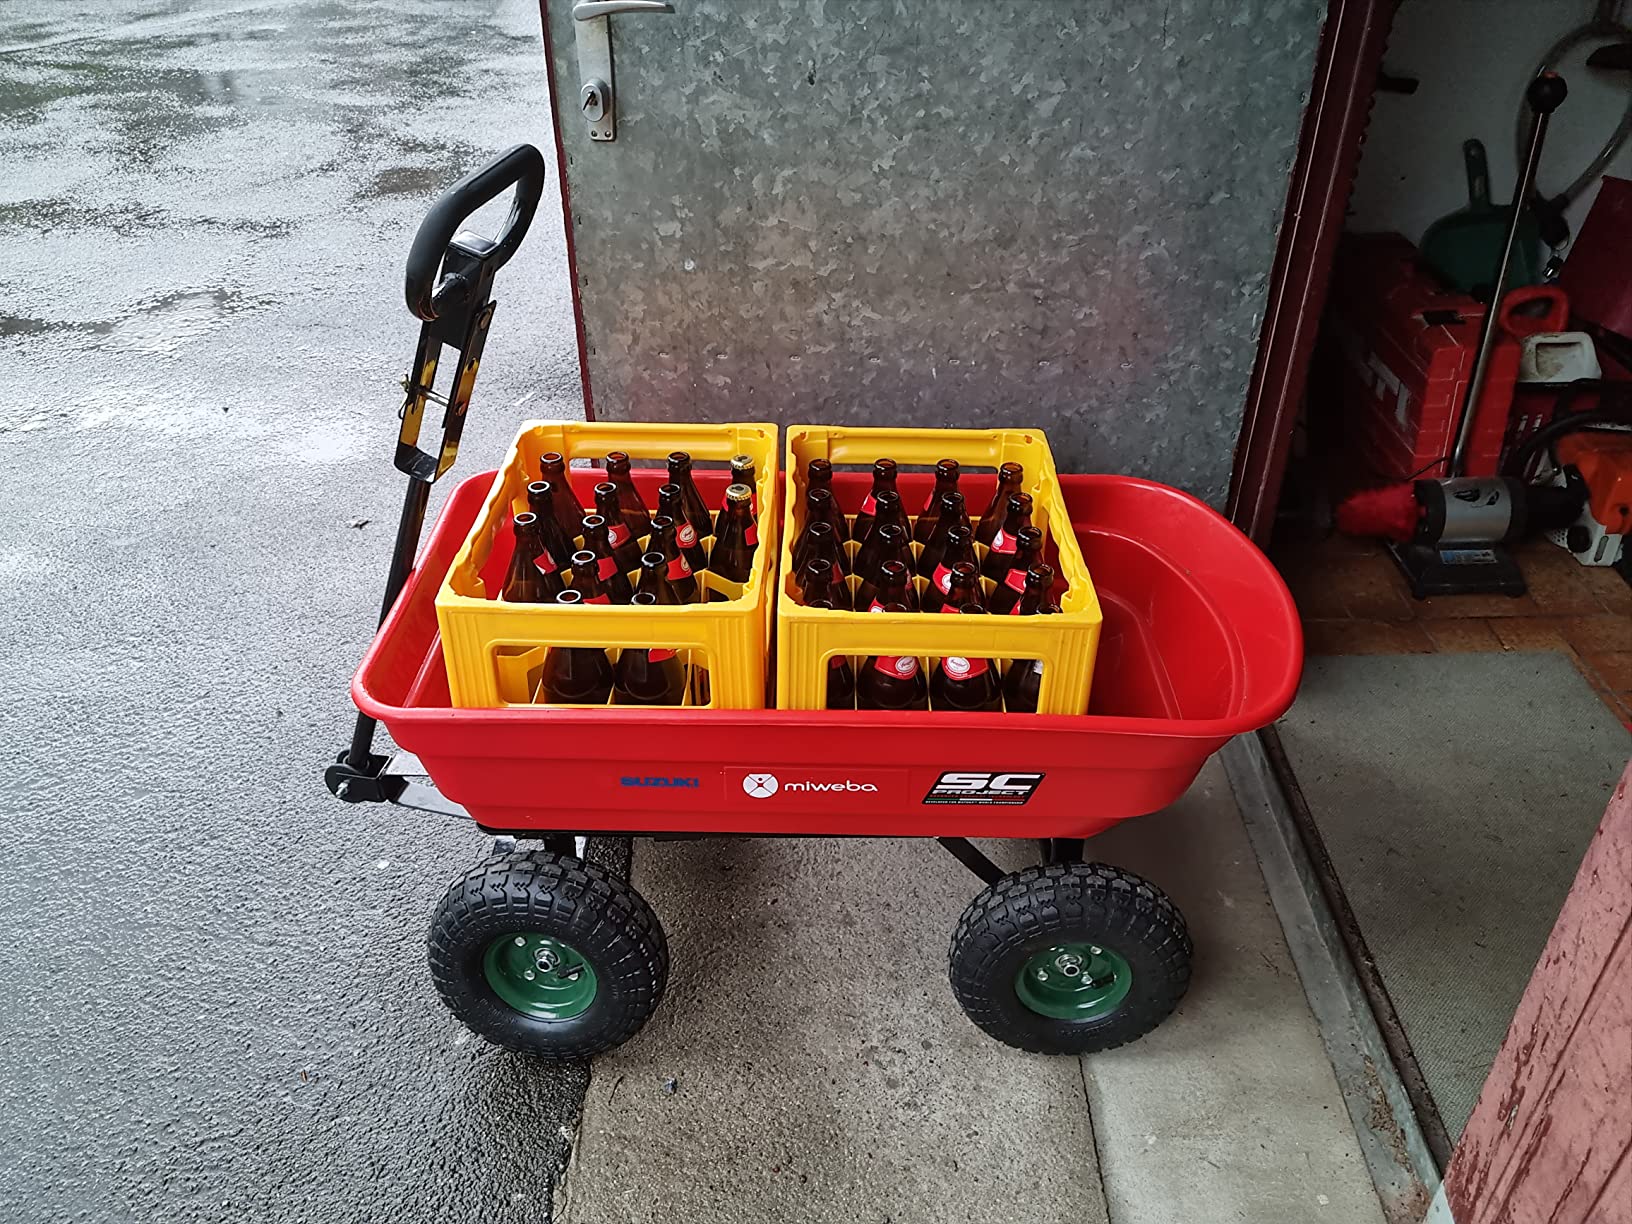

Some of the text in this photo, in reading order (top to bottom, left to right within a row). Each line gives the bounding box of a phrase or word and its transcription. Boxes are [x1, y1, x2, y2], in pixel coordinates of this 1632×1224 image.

[620, 776, 699, 788] SUZUKI
[784, 780, 878, 792] miweba
[936, 773, 1041, 790] SC
